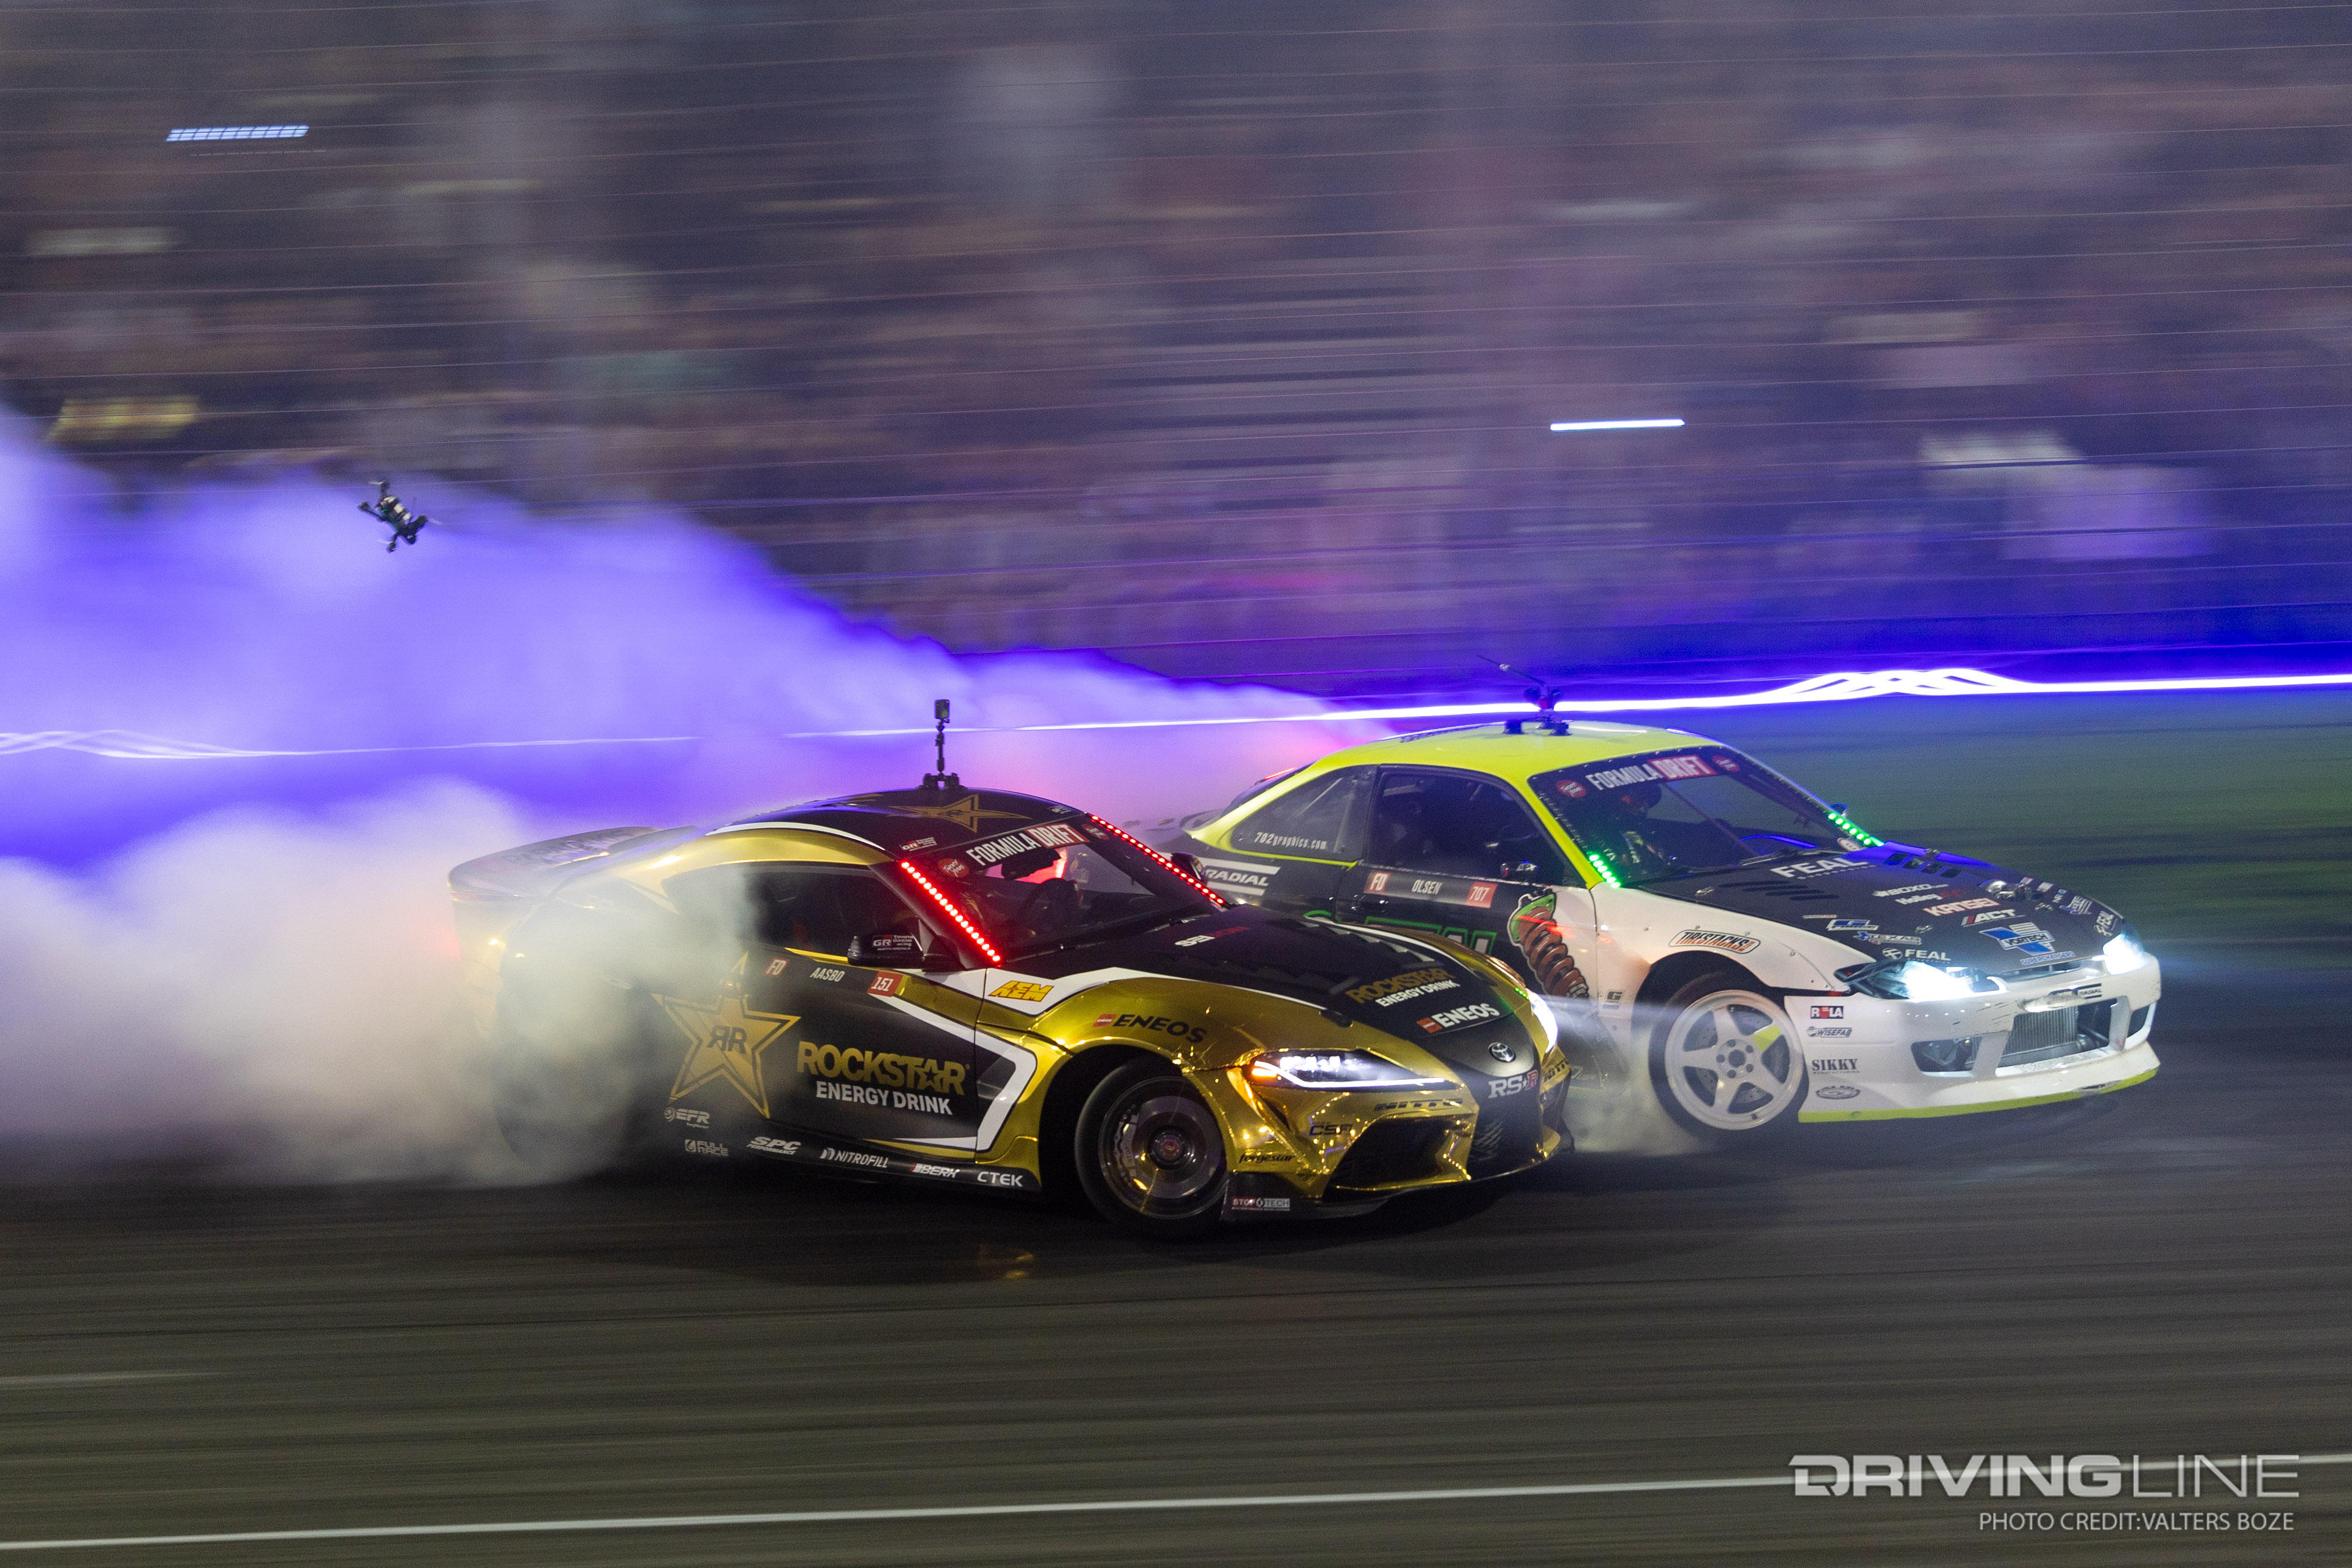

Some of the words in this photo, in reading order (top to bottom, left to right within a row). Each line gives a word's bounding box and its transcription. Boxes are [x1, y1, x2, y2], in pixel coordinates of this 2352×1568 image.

[1585, 763, 1664, 790] FORMULA
[1650, 756, 1713, 779] DRIFT
[966, 833, 1041, 866] FORMULA
[1028, 824, 1085, 846] DRIFT
[1254, 832, 1327, 850] 702graphics.com
[1205, 869, 1269, 886] RADIAL
[1770, 858, 1869, 878] FEAL
[1371, 872, 1387, 891] FD
[1411, 879, 1442, 895] OLSEN
[1469, 886, 1491, 901] 707
[1973, 909, 2016, 923] ACT
[1676, 932, 1750, 949] TIRESTACKS
[2003, 933, 2049, 946] VORTECH
[1905, 949, 1951, 960] FEAL
[766, 959, 786, 975] FD
[810, 967, 845, 982] AASBO
[871, 977, 894, 992] 151
[1375, 987, 1425, 1007] ENERGY
[1421, 980, 1461, 995] DRINK
[1431, 1003, 1500, 1027] ENEOS
[1112, 1014, 1208, 1043] ENEOS
[797, 1041, 966, 1096] ROCKSTAR
[1812, 1058, 1858, 1071] SIKKY
[816, 1080, 889, 1106] ENERGY
[893, 1091, 952, 1115] DRINK
[676, 1108, 710, 1124] EFR
[697, 1140, 728, 1150] FULL
[697, 1147, 729, 1156] RACE
[750, 1136, 801, 1150] SPC
[835, 1150, 889, 1168] NITROFILL
[922, 1164, 960, 1178] BERK
[977, 1171, 1023, 1187] CTEK
